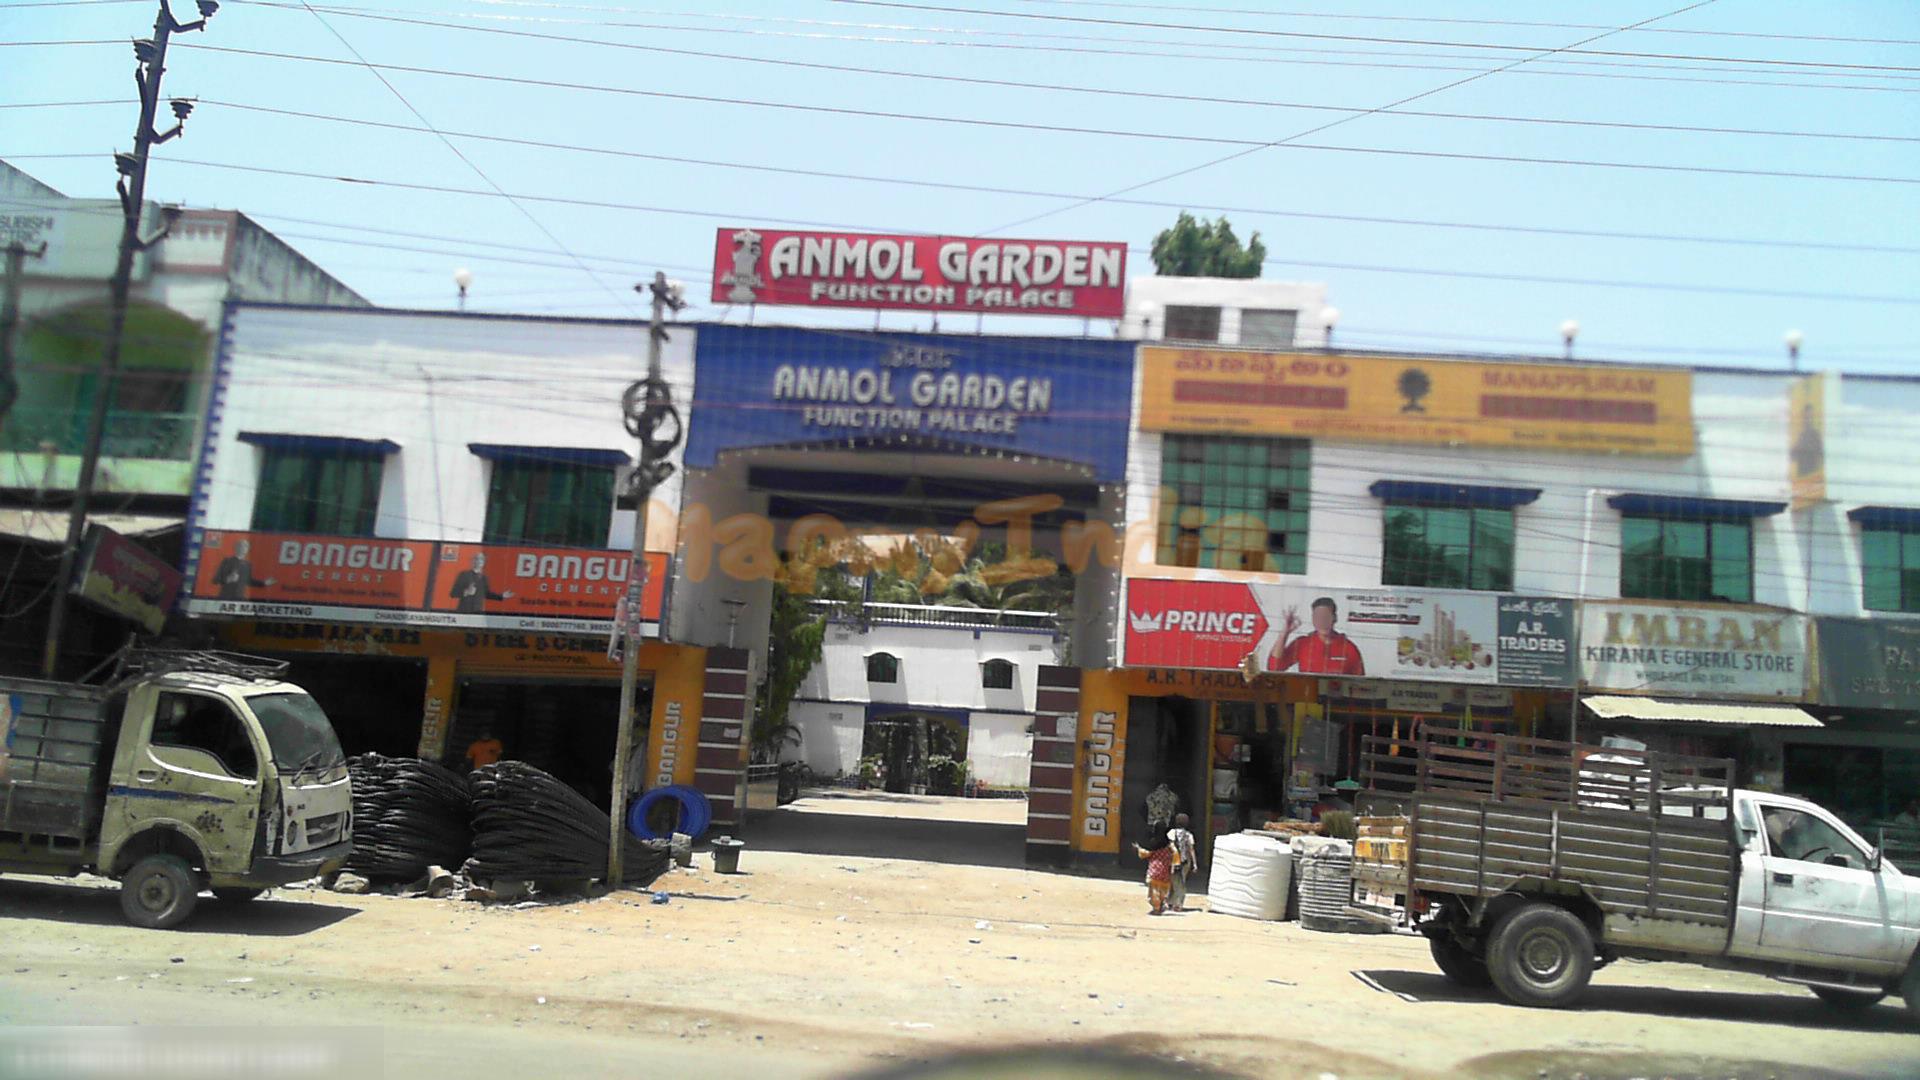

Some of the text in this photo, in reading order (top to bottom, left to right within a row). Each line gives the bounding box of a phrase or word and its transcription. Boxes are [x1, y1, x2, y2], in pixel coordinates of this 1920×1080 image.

[769, 235, 1120, 288] ANMOL GARDEN
[810, 281, 1075, 309] FUNCTION PALACE
[773, 364, 1051, 413] ANMOL GARDEN
[803, 406, 1018, 433] FUNCTION PALACE
[279, 540, 414, 572] BANGUR
[516, 553, 649, 584] BANGU
[301, 570, 384, 583] CEMENT
[539, 583, 623, 596] CEMENT
[219, 603, 312, 617] AR MARKETING
[1164, 610, 1257, 634] PRINCE
[1516, 621, 1548, 636] A.R.
[1604, 612, 1783, 651] IMRAN
[1499, 636, 1566, 653] TRADERS
[1586, 646, 1657, 665] KIRANA
[1674, 650, 1738, 669] GENERAL
[1744, 653, 1795, 673] STORE
[656, 701, 681, 787] BANGUR
[1084, 711, 1117, 837] BANGUR
